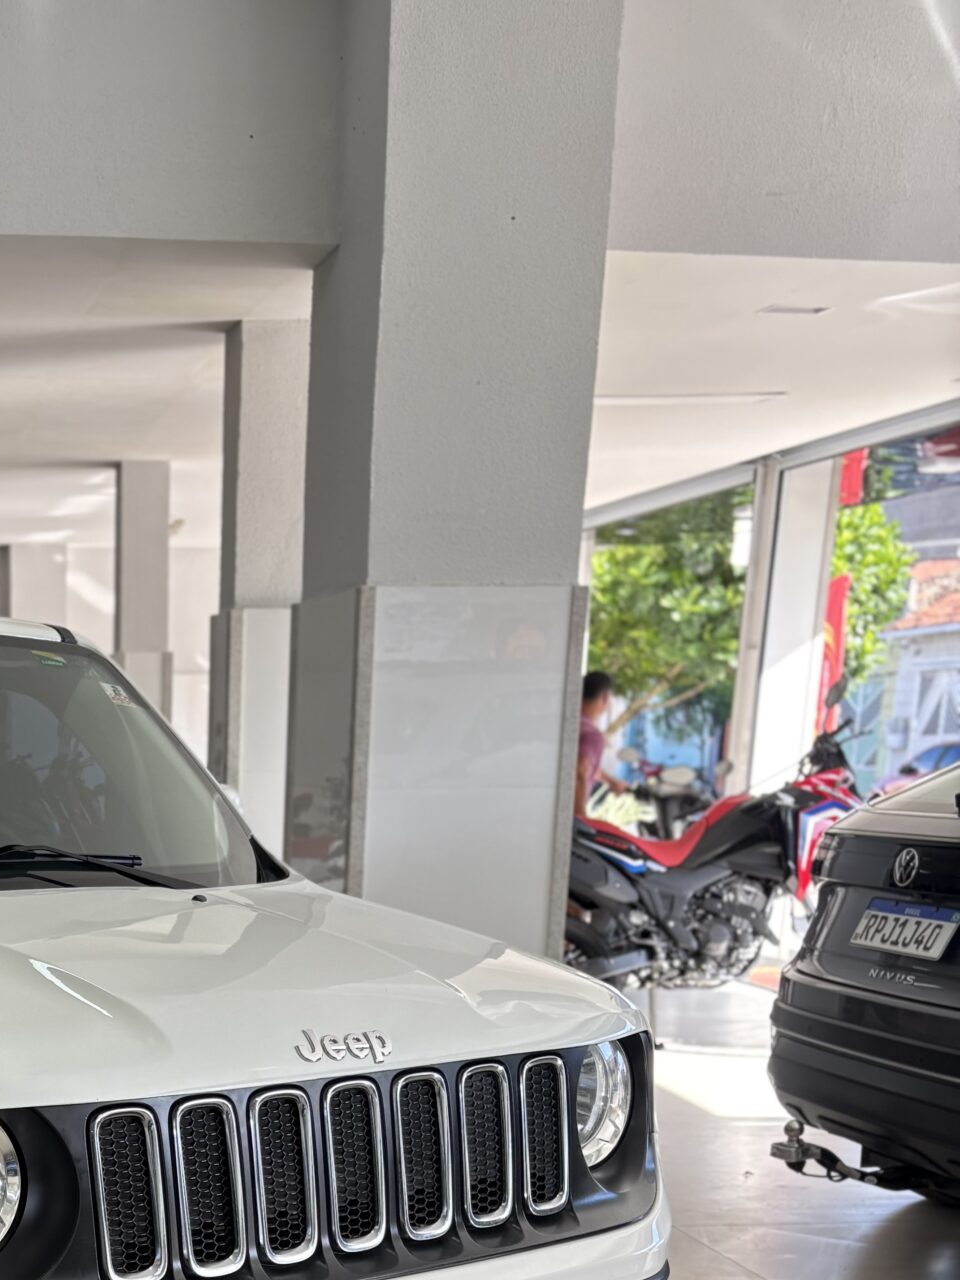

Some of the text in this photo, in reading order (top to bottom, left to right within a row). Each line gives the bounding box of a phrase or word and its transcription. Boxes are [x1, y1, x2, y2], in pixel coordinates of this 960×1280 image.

[859, 914, 944, 952] RPJ1J40
[868, 968, 916, 985] NIVUS
[294, 1028, 392, 1064] Jeep
